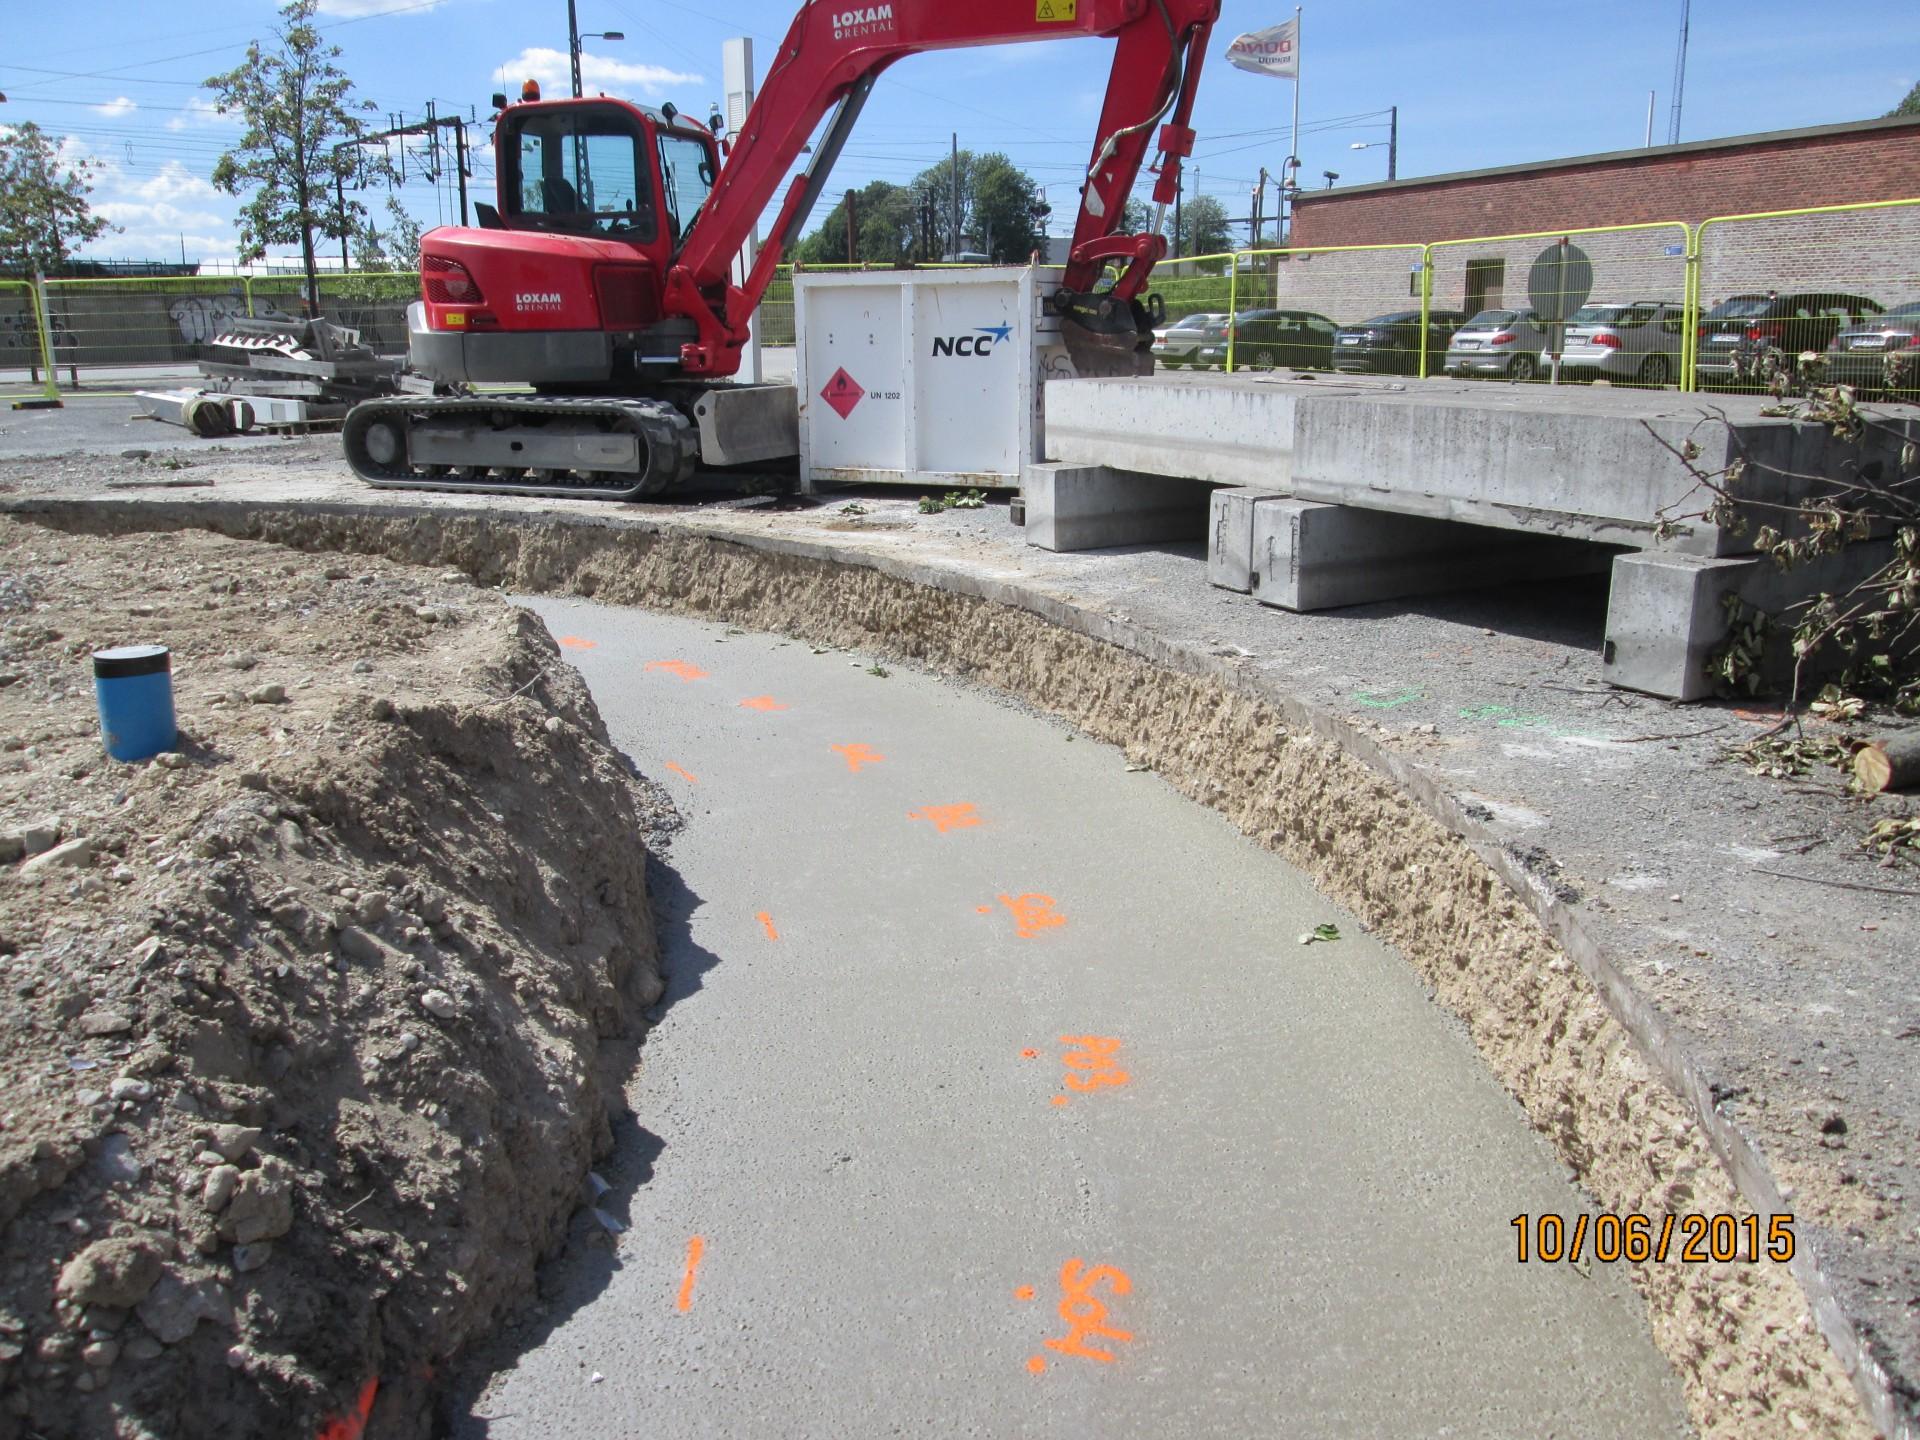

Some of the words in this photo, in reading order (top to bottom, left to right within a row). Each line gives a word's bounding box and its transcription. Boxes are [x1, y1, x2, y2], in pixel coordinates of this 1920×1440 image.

[832, 4, 893, 28] LOXAM
[515, 293, 562, 304] LOXAM
[932, 336, 993, 357] NCC
[870, 391, 882, 400] UN
[885, 391, 901, 400] 1202
